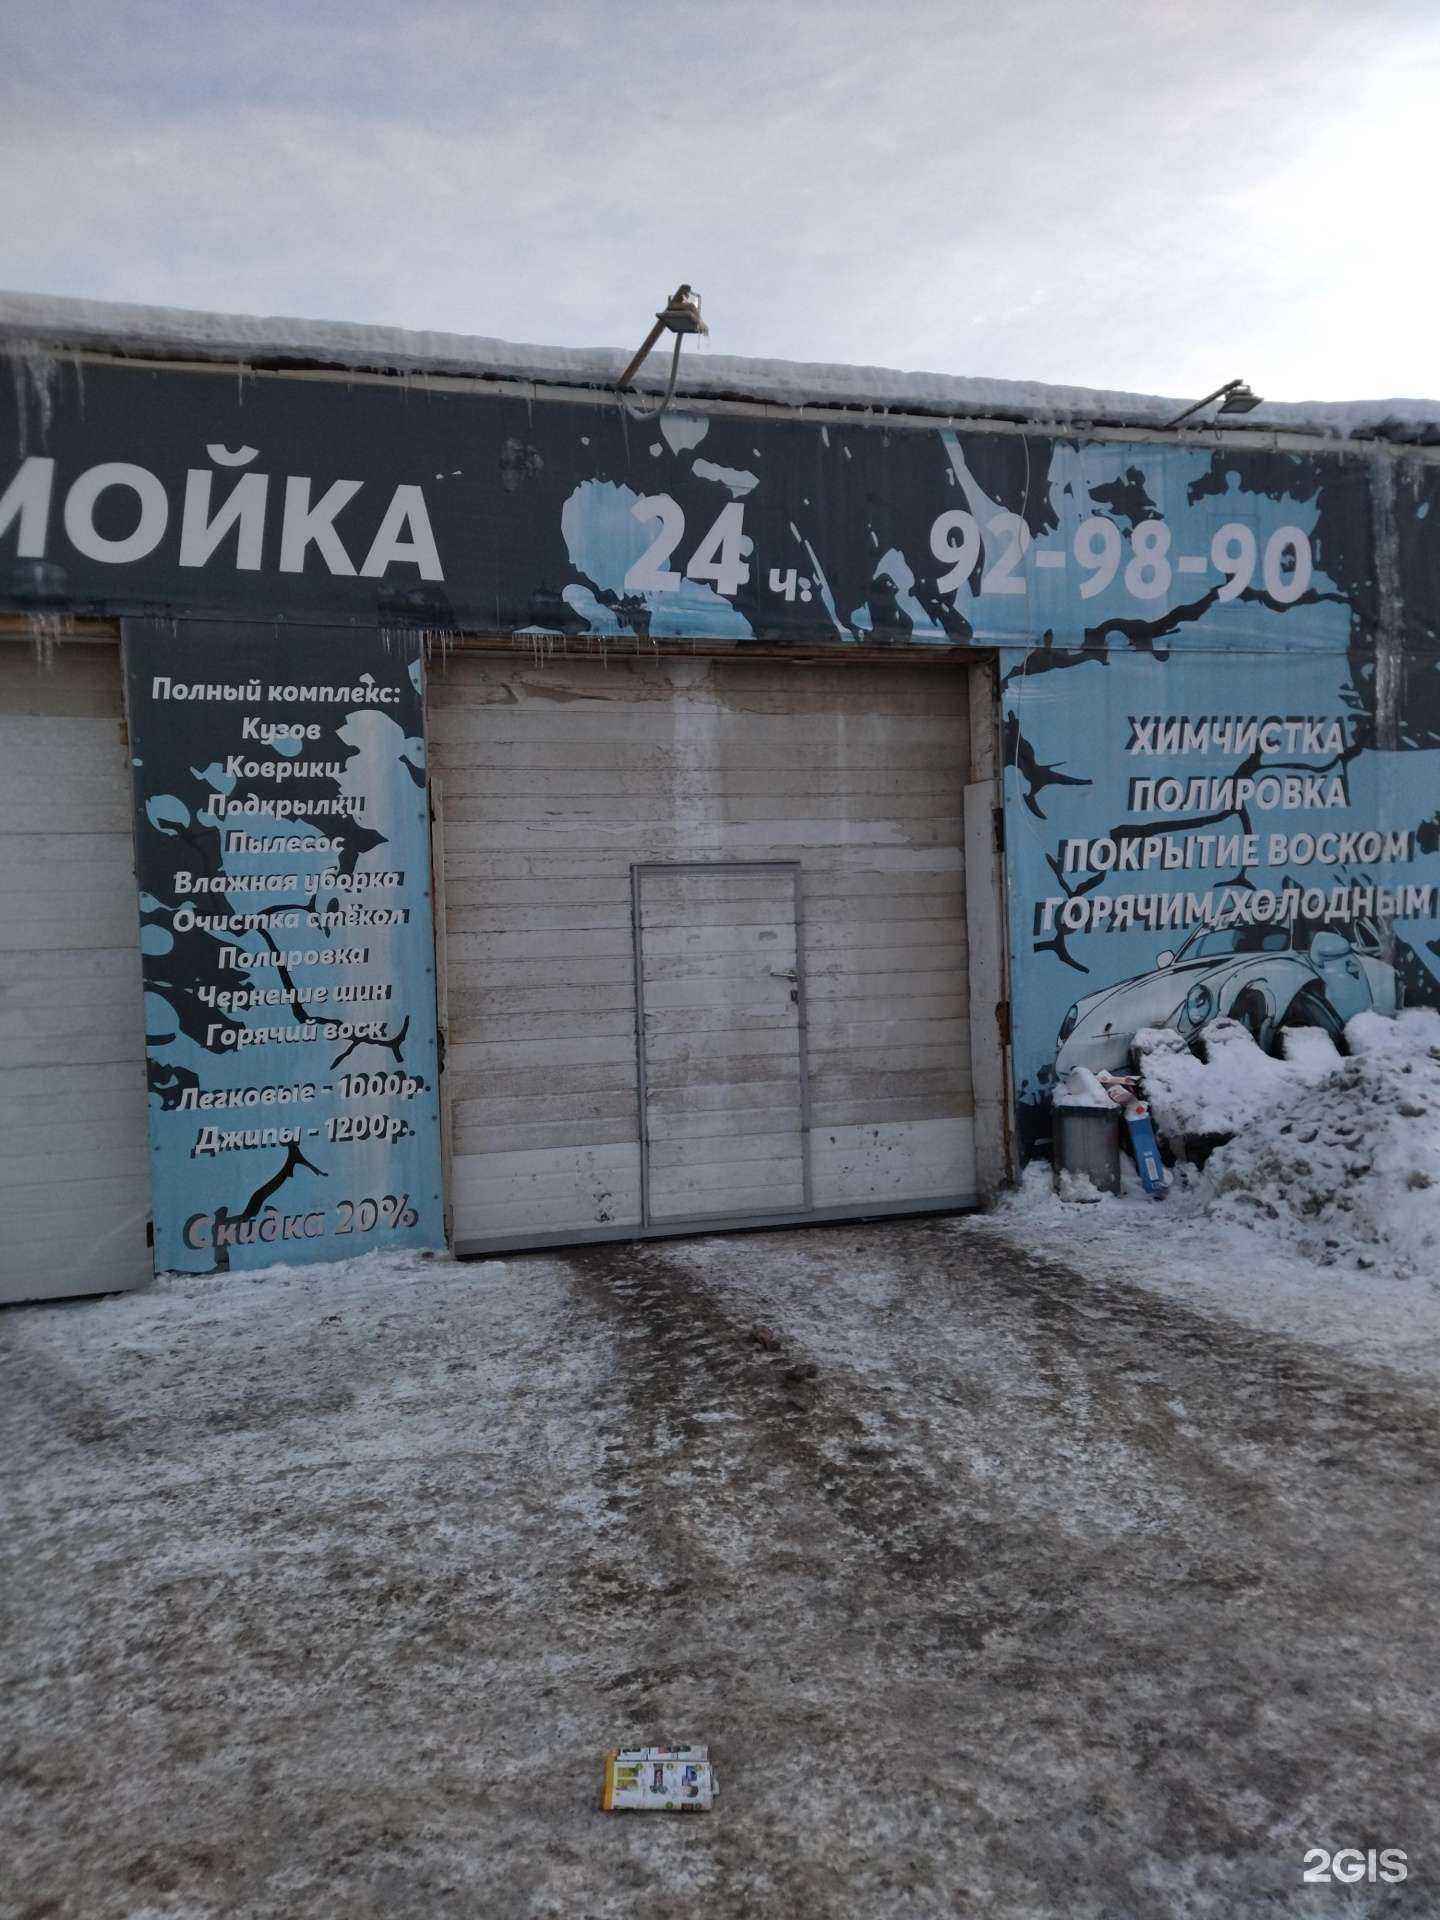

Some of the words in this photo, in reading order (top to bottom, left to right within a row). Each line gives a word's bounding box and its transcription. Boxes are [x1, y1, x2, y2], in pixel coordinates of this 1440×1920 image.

[624, 493, 750, 595] 24
[930, 509, 1312, 603] 92-98-90
[152, 677, 261, 702] Полный
[268, 683, 400, 703] комплекс:
[242, 717, 321, 744] Кузов
[1129, 721, 1344, 755] ХИМЧИСТКА
[226, 755, 345, 782] Коврики
[207, 793, 364, 820] Подкрылки
[1132, 776, 1348, 812] ПОЛИРОВКА
[228, 831, 345, 855] Пылесос
[1063, 834, 1260, 872] ПОКРЫТИЕ
[1269, 831, 1409, 865] ВОСКОМ
[173, 871, 298, 894] Влажная
[304, 866, 402, 895] уборка
[173, 909, 298, 932] Очистка
[218, 947, 367, 971] Полировка
[198, 985, 327, 1012] Чернение
[333, 985, 391, 1003] шин
[206, 1019, 318, 1050] Горячий
[323, 1019, 386, 1041] воск
[176, 1085, 315, 1111] Легковые
[195, 1126, 301, 1153] Джипы
[183, 1206, 325, 1249] Скидка
[335, 1194, 418, 1235] 20%
